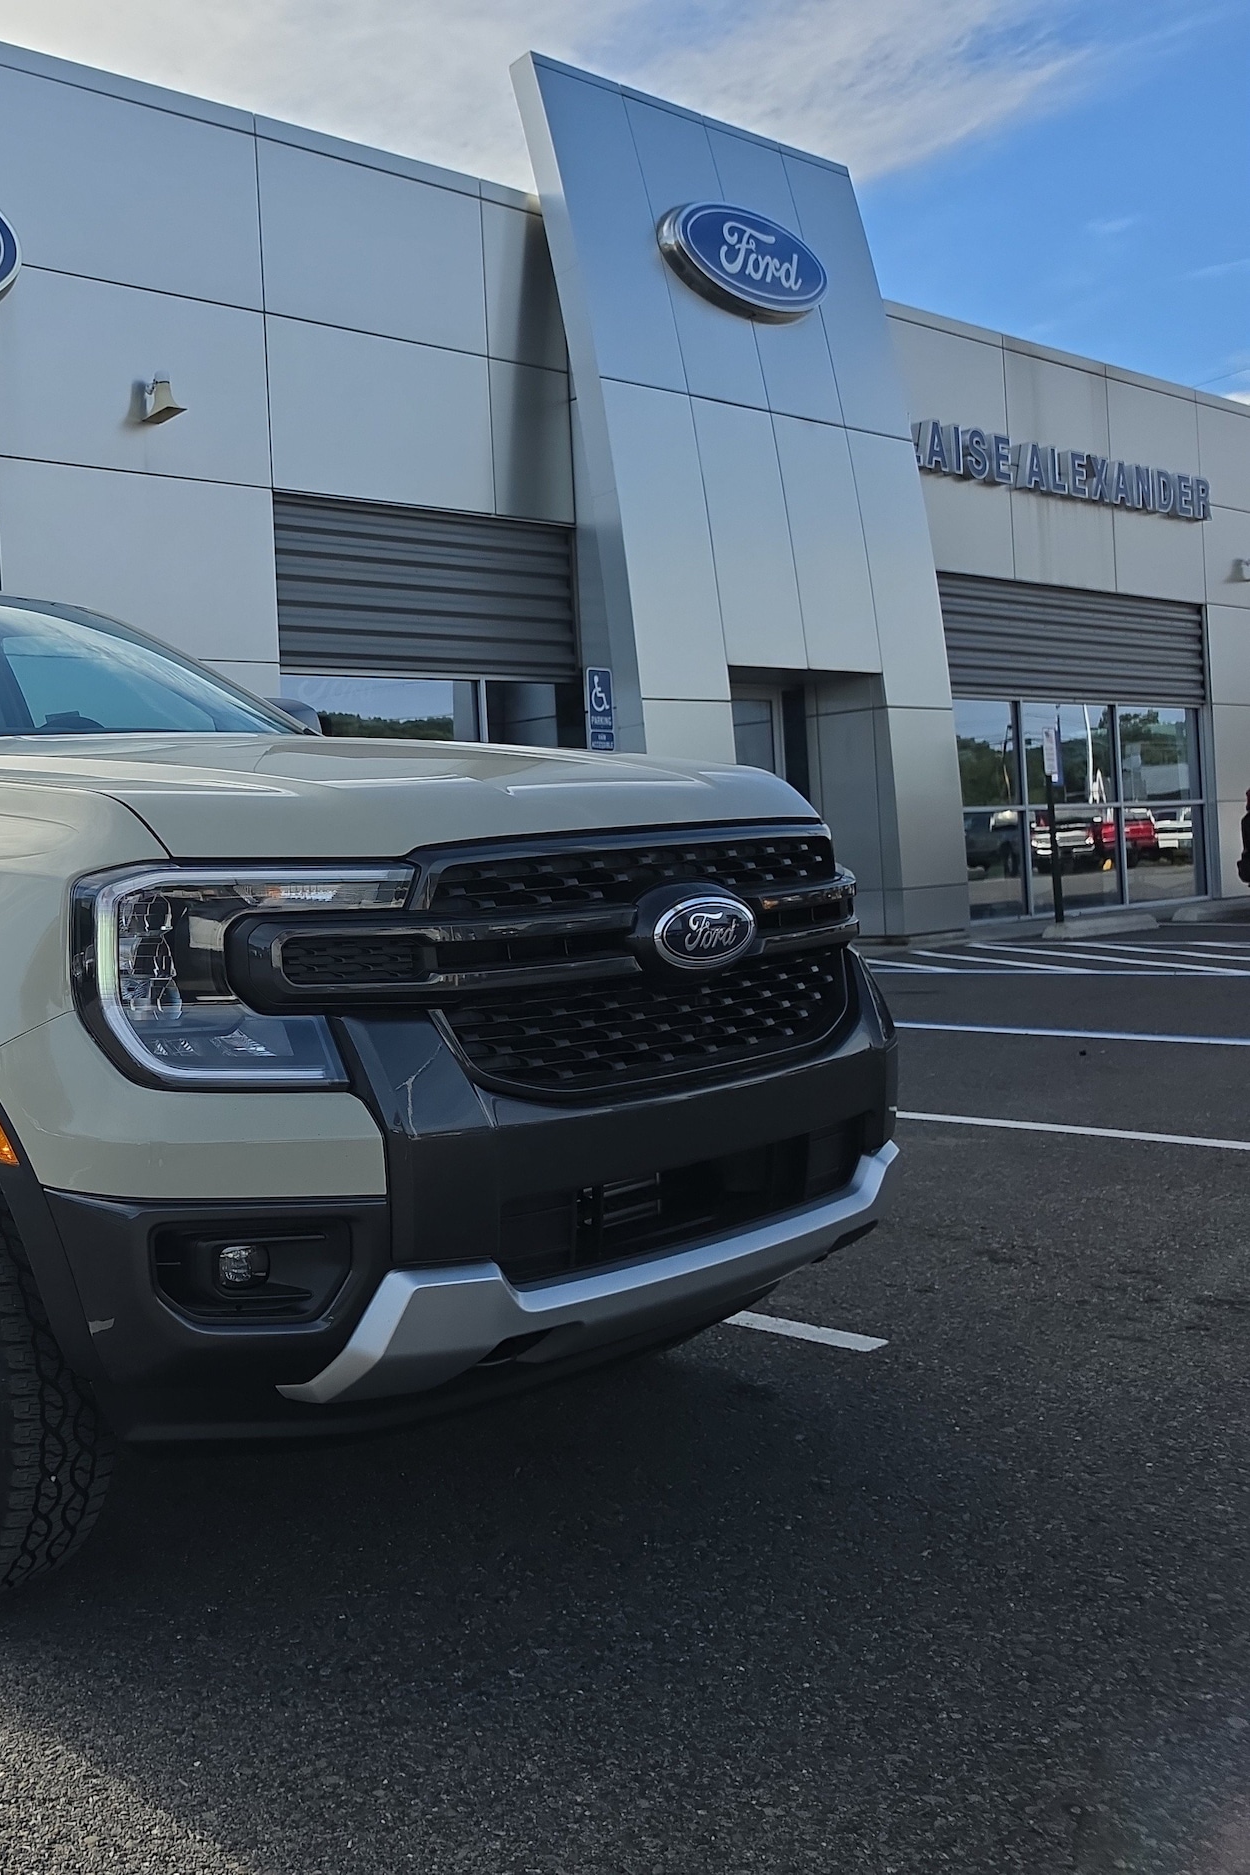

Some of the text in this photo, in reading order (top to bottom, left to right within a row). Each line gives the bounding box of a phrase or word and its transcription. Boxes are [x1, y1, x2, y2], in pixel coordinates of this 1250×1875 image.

[719, 220, 803, 291] Ford
[914, 419, 1212, 521] AISE ALEXANDER
[591, 715, 612, 726] PARKING
[685, 911, 738, 952] Ford
